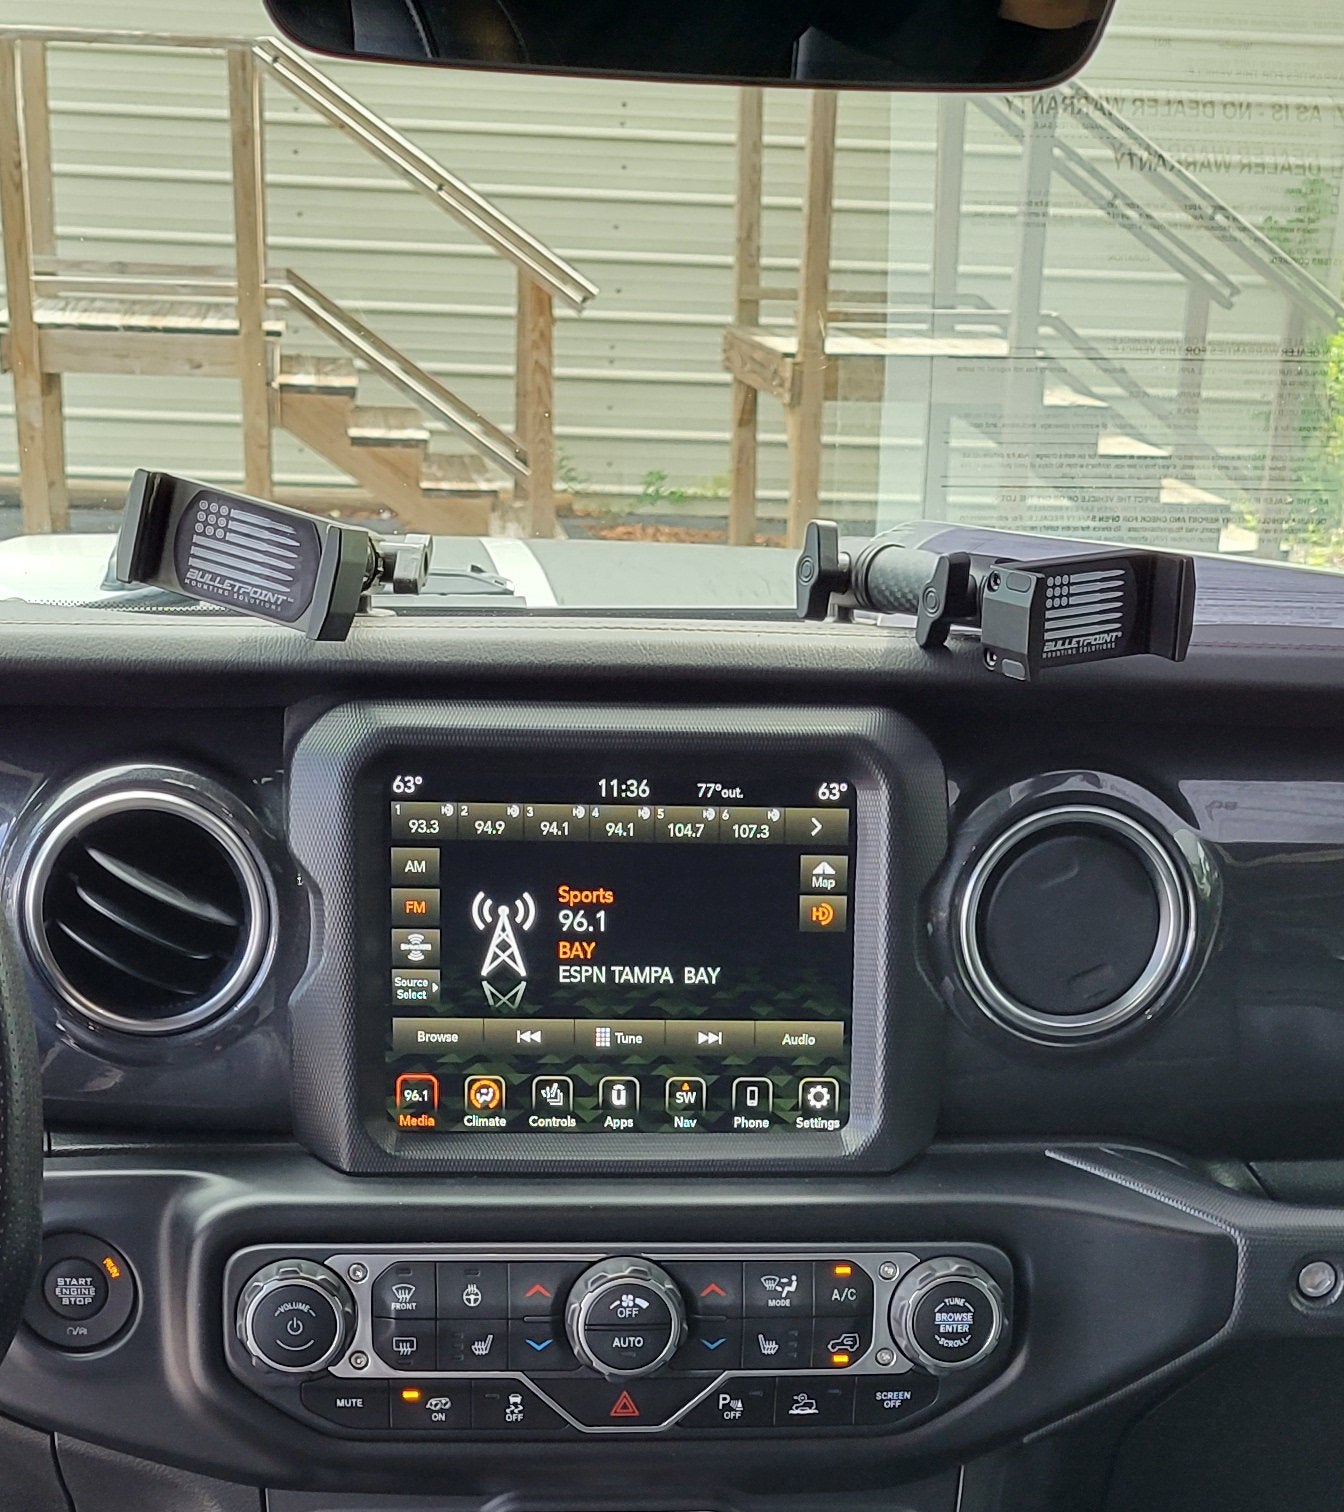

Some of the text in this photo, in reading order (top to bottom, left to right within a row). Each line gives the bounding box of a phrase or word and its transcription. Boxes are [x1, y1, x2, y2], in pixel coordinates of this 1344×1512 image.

[598, 779, 650, 798] 11:36
[394, 805, 401, 816] 1
[460, 806, 468, 816] 2
[526, 806, 534, 817] 3
[591, 807, 599, 818] 4
[656, 808, 664, 819] 5
[721, 809, 729, 820] 6
[408, 819, 440, 834] 93.3
[474, 820, 506, 835] 94.9
[540, 821, 569, 836] 94.1
[606, 822, 634, 837] 94.1
[667, 823, 705, 838] 104.7
[732, 824, 770, 839] 107.3
[404, 861, 426, 873] AM
[811, 876, 836, 890] Map
[558, 886, 614, 907] Sports
[405, 901, 427, 914] FM
[558, 910, 607, 932] 96.1
[558, 941, 596, 959] BAY
[558, 965, 721, 985] ESPN TAMPA BAY
[394, 976, 429, 989] Source
[396, 988, 427, 1000] Select
[417, 1030, 459, 1043] Browse
[614, 1032, 643, 1045] Tune
[782, 1033, 816, 1046] Audio
[403, 1088, 429, 1102] 96.1
[675, 1091, 697, 1104] SW
[399, 1114, 436, 1127] Media
[463, 1115, 507, 1127] Climate
[528, 1115, 577, 1128] Controls
[603, 1116, 634, 1129] Apps
[673, 1116, 698, 1129] Nav
[733, 1116, 770, 1129] Phone
[795, 1116, 840, 1130] Settings
[57, 1277, 93, 1286] START
[55, 1287, 96, 1296] ENGINE
[831, 1288, 857, 1301] A/C
[61, 1297, 93, 1305] STOP
[277, 1301, 311, 1313] VOLUME
[391, 1302, 417, 1311] FRONT
[767, 1298, 791, 1307] MODE
[944, 1297, 965, 1307] TUNE
[617, 1307, 639, 1319] OFF
[934, 1312, 974, 1323] BROWSE
[939, 1323, 970, 1333] ENTER
[612, 1336, 644, 1349] AUTO
[938, 1336, 968, 1348] SCROLL
[875, 1391, 912, 1401] SCREEN
[336, 1398, 364, 1408] MUTE
[883, 1400, 902, 1409] OFF
[431, 1412, 446, 1422] ON
[505, 1412, 524, 1423] OFF
[723, 1411, 742, 1420] OFF
